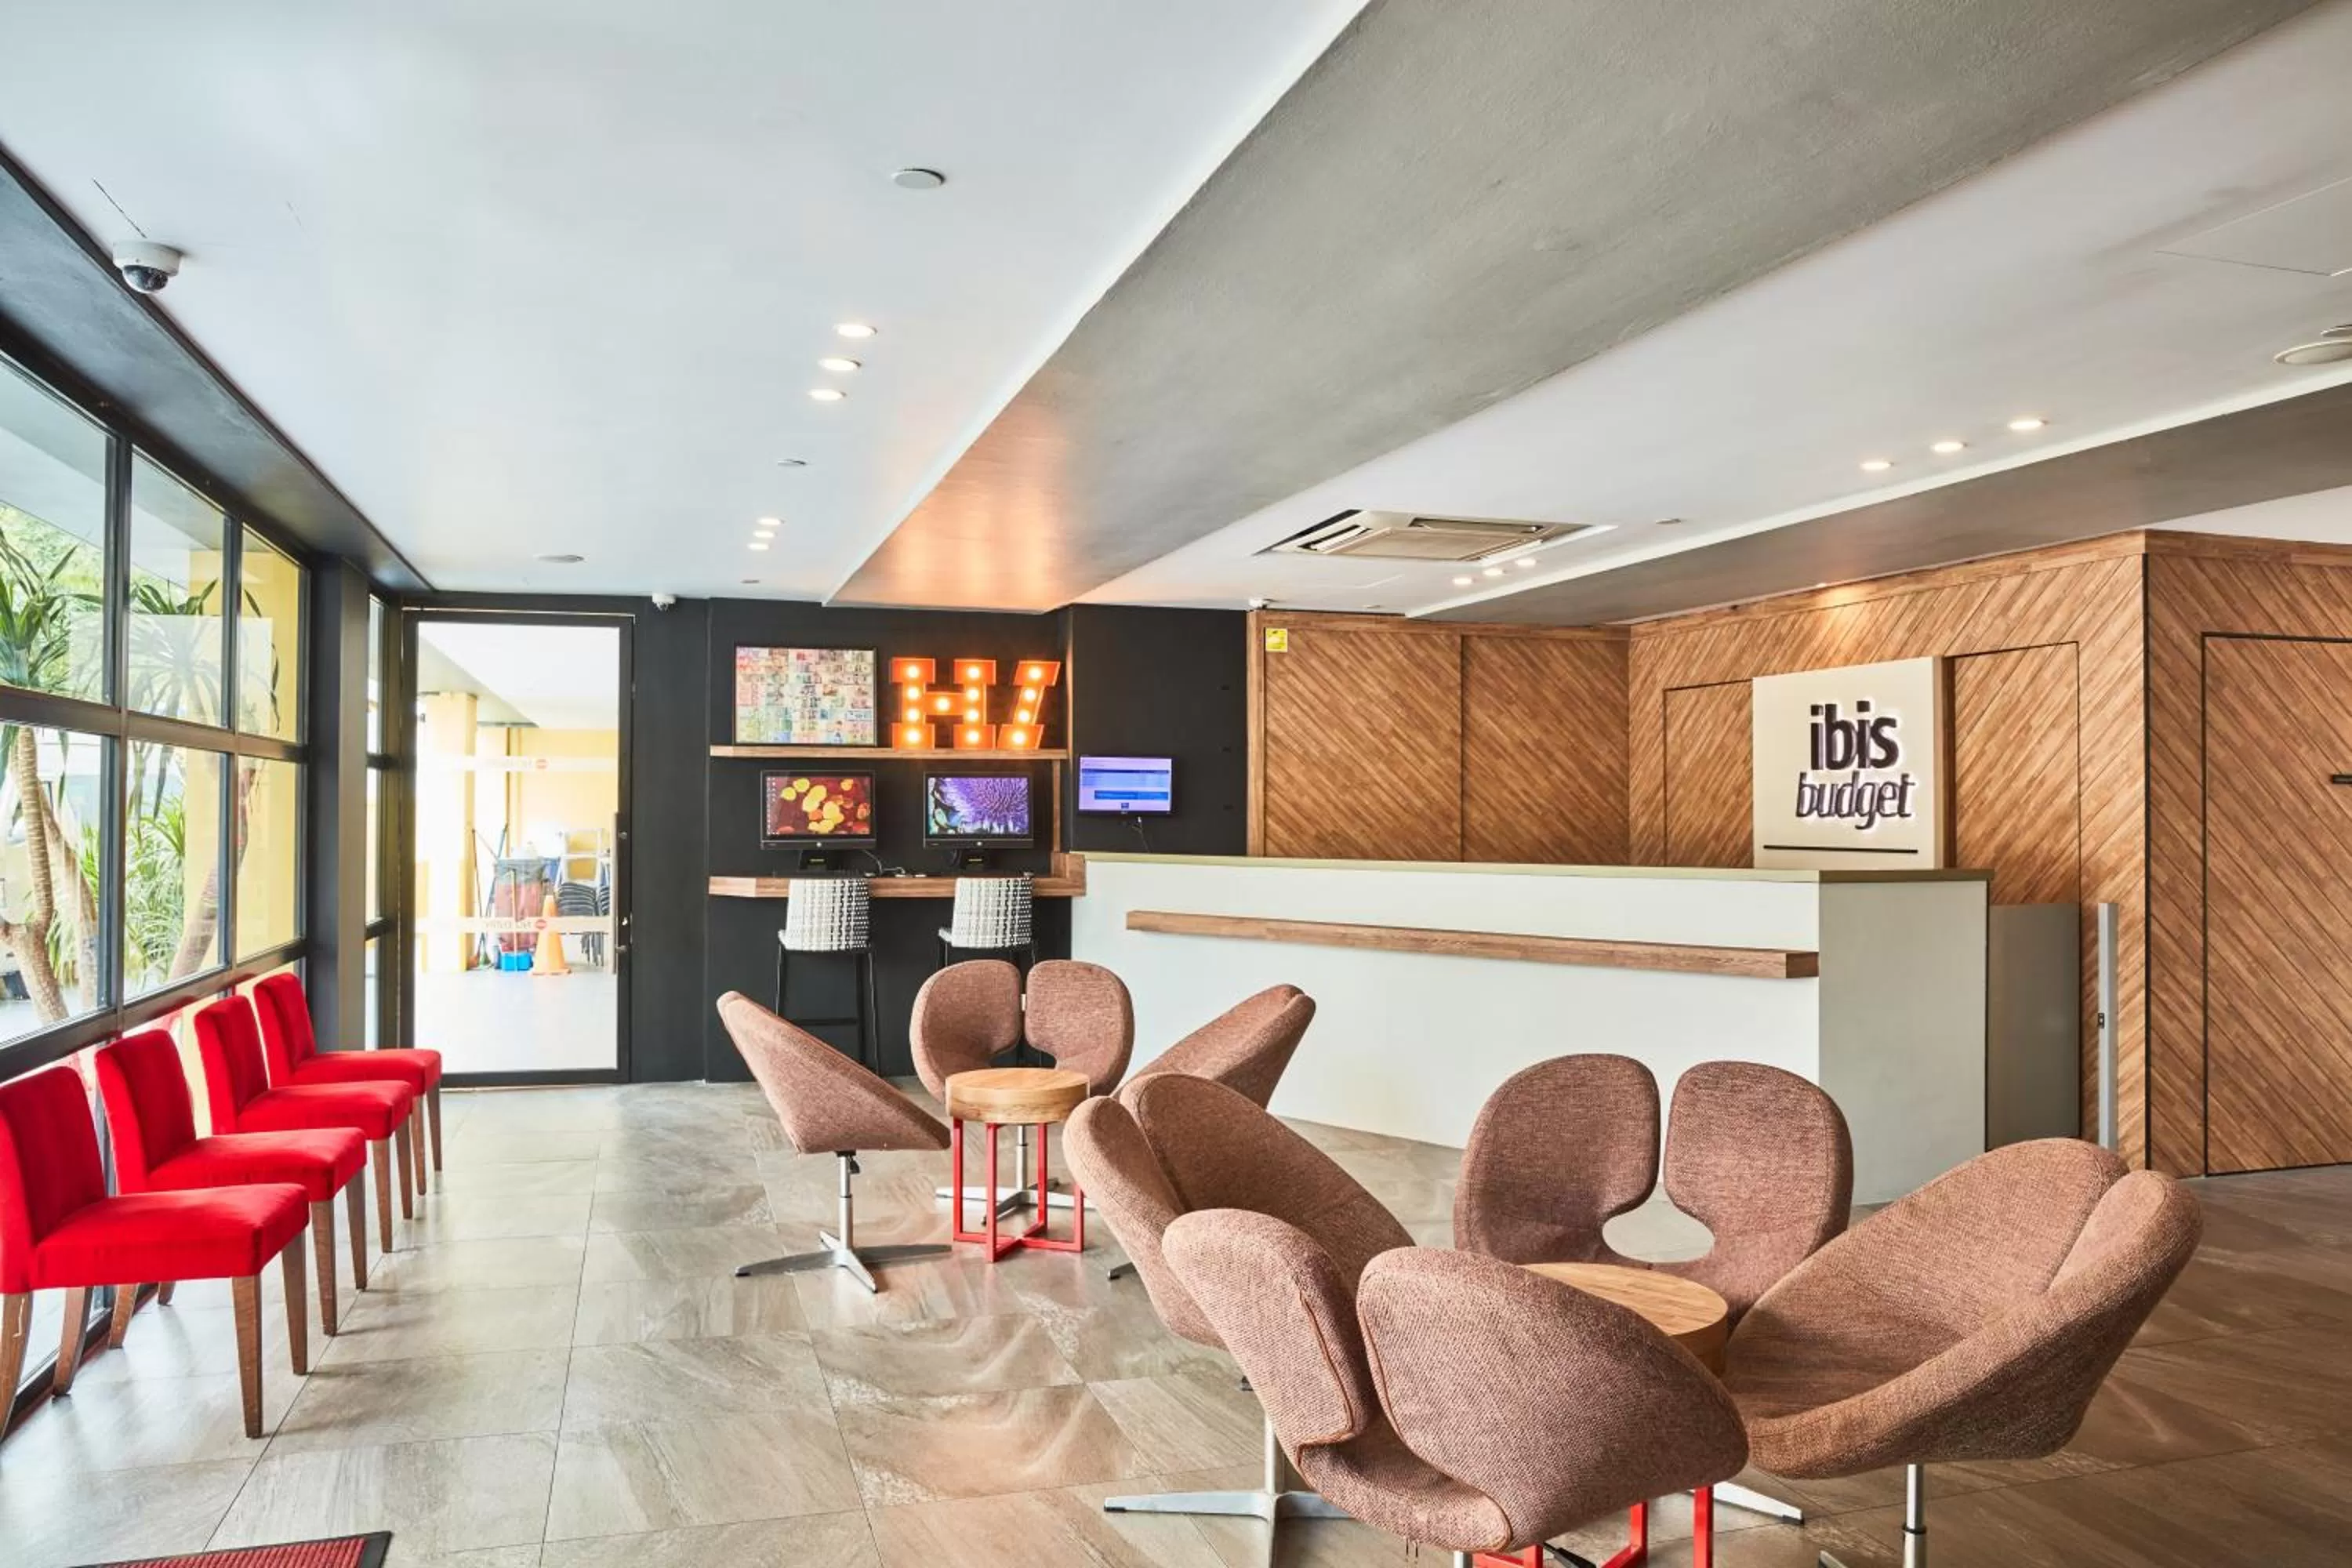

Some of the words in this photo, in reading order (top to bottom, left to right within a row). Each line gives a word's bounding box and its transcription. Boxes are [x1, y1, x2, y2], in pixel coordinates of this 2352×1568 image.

[891, 656, 1062, 751] HI
[1809, 699, 1900, 771] ibis
[1795, 771, 1916, 830] budget
